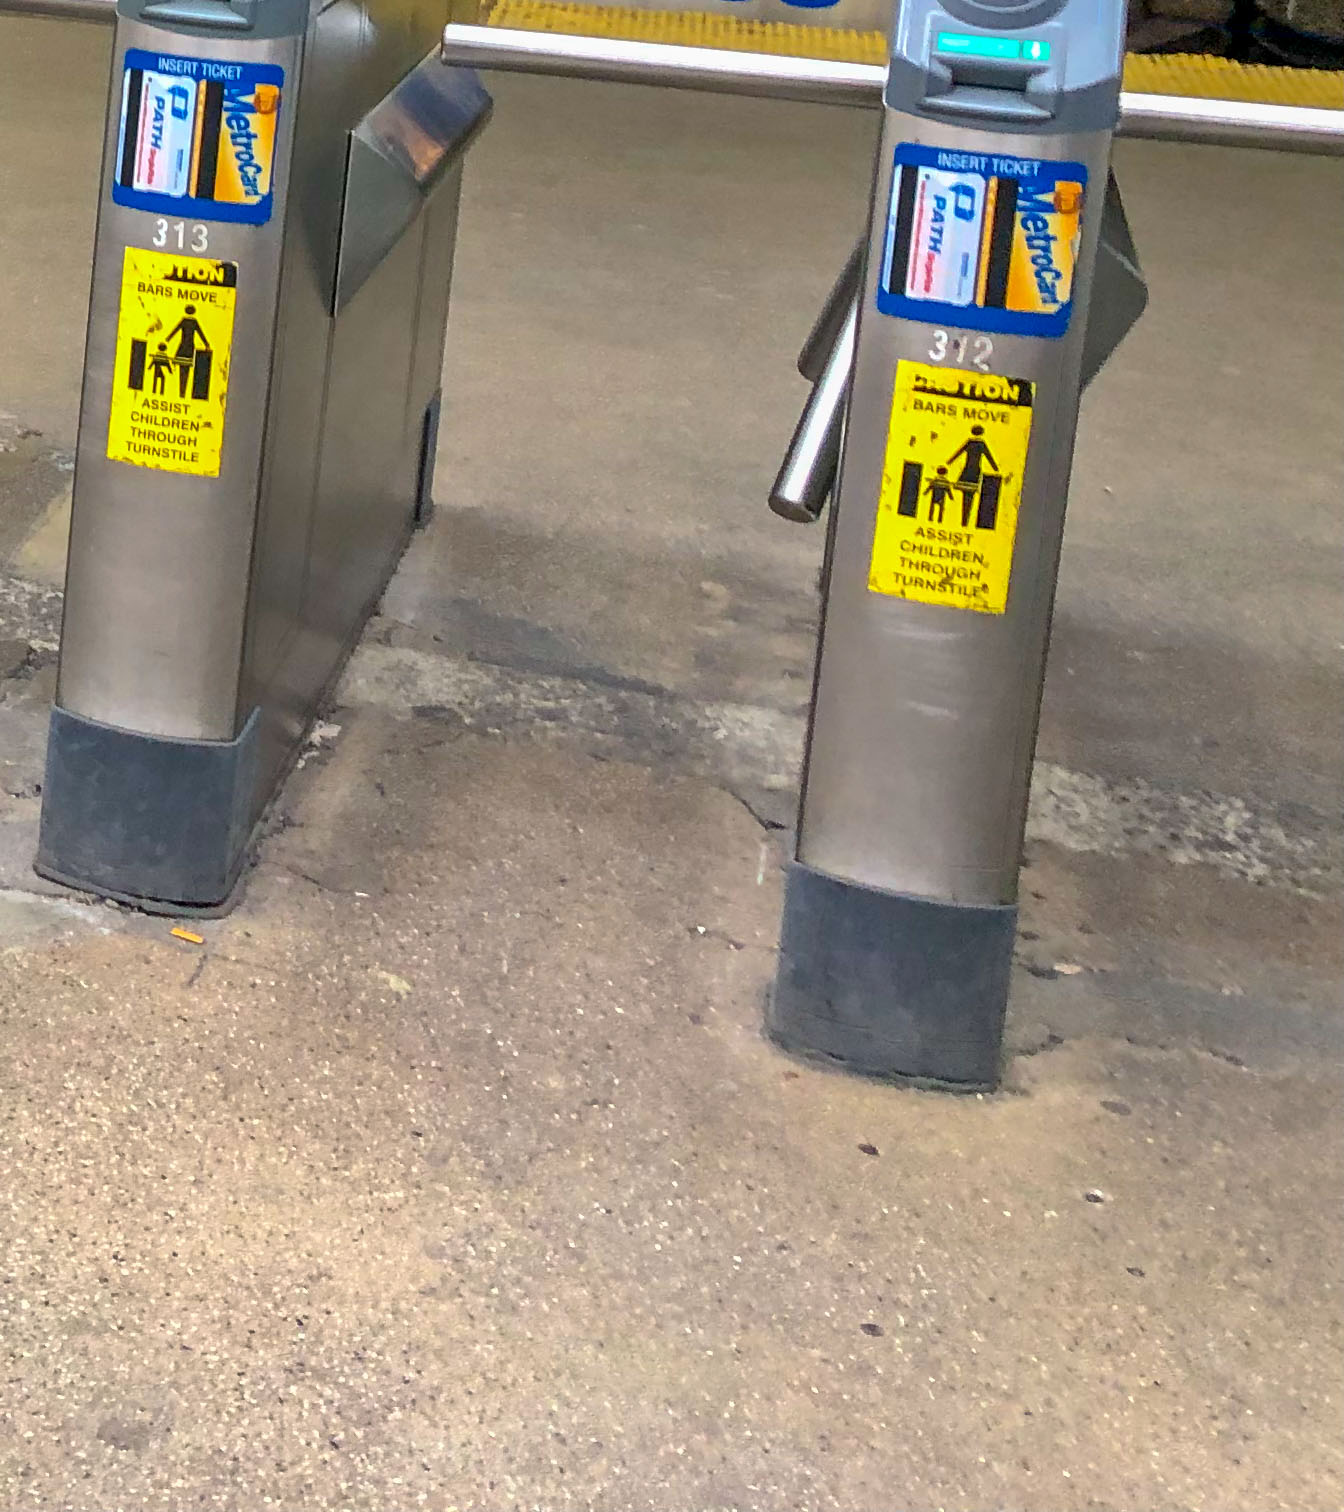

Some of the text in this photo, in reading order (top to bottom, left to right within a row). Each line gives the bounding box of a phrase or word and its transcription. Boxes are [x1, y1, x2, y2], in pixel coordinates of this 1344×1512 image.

[158, 56, 243, 81] INSERT TICKET
[150, 95, 166, 150] PATH
[937, 151, 1042, 178] INSERT TICKET
[151, 218, 210, 254] 313
[926, 193, 947, 255] PATH
[137, 281, 218, 304] BARS MOVE
[927, 329, 994, 372] 312
[141, 397, 191, 416] ASSIST
[912, 398, 1011, 425] BARS MOVE
[130, 410, 201, 432] CHILDREN
[129, 425, 199, 448] THROUGH
[125, 440, 200, 463] TURNSTILE
[914, 526, 974, 546] ASSIST
[899, 539, 985, 564] CHILDREN
[899, 556, 982, 582] THROUGH
[892, 571, 983, 599] TURNSTILE
